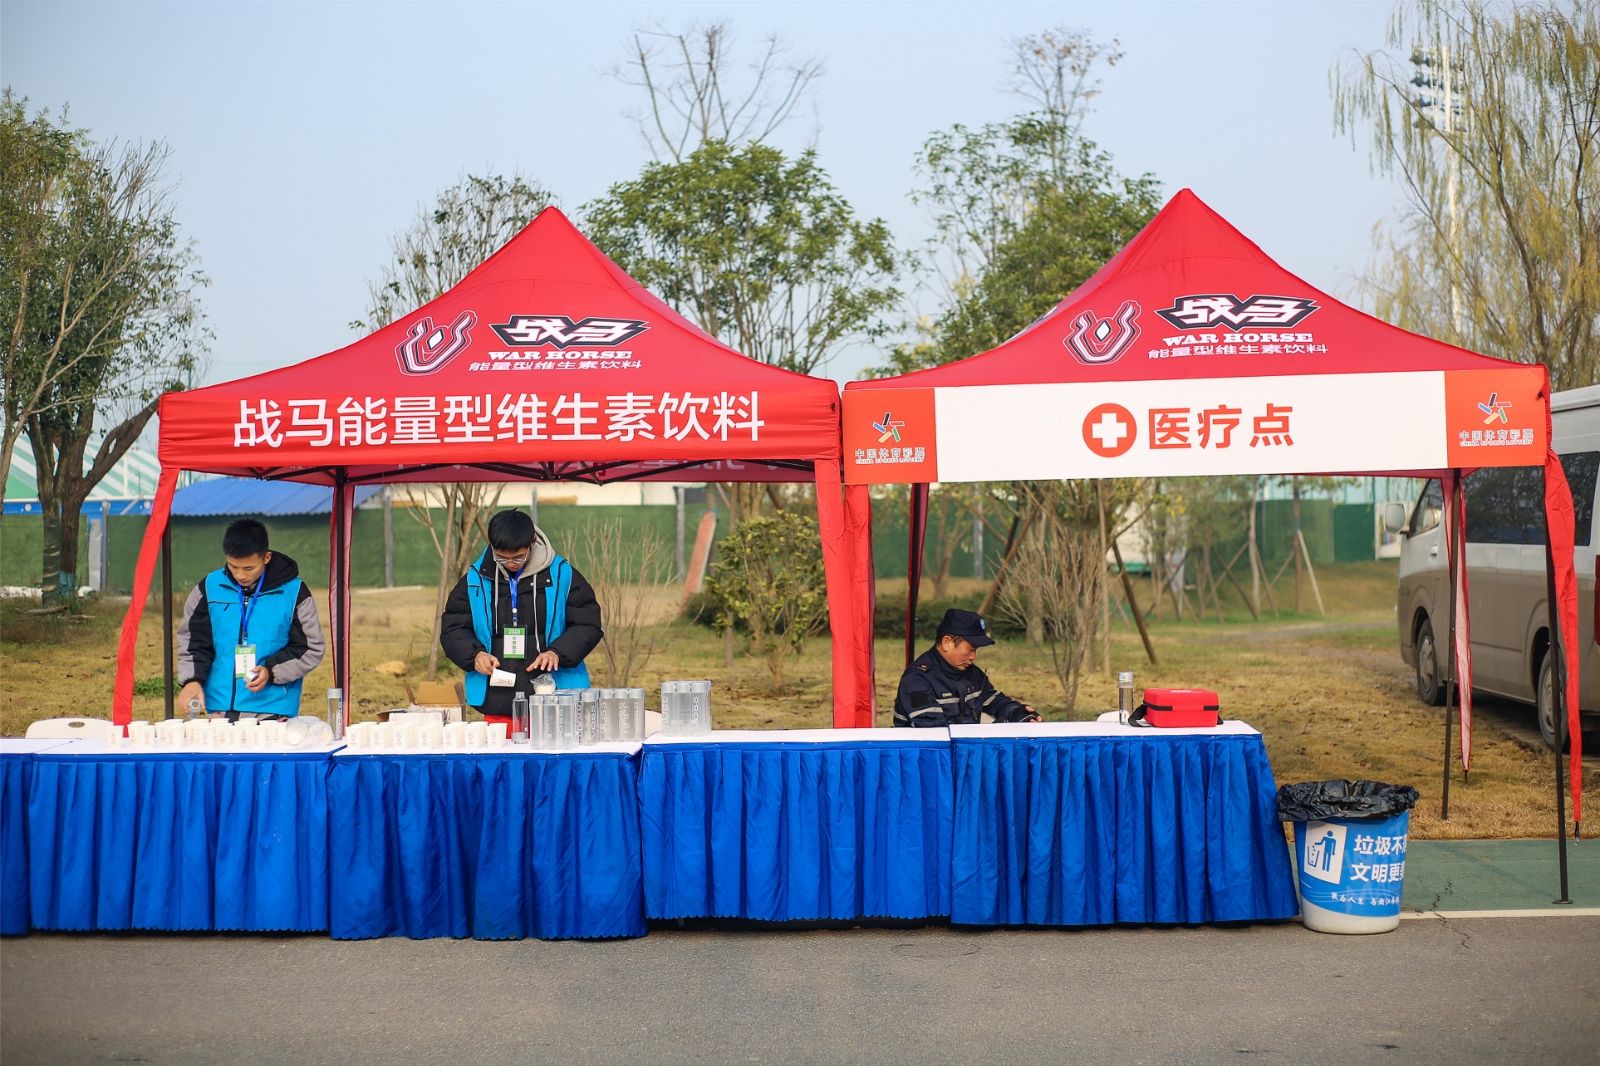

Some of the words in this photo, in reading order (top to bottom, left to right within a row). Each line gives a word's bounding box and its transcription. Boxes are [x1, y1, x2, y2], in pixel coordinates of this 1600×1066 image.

[1163, 334, 1219, 346] WAR
[1223, 332, 1313, 343] HORSE
[488, 350, 541, 360] WAR
[544, 350, 632, 360] HORSE
[1148, 344, 1328, 359] 能量型维生素饮料
[468, 360, 642, 372] 能量型维生素饮料
[233, 391, 765, 448] 战马能量型维生素饮料
[1148, 403, 1294, 450] 医疗点
[1458, 429, 1534, 441] 中国体育彩票
[855, 447, 926, 459] 中国体育彩票
